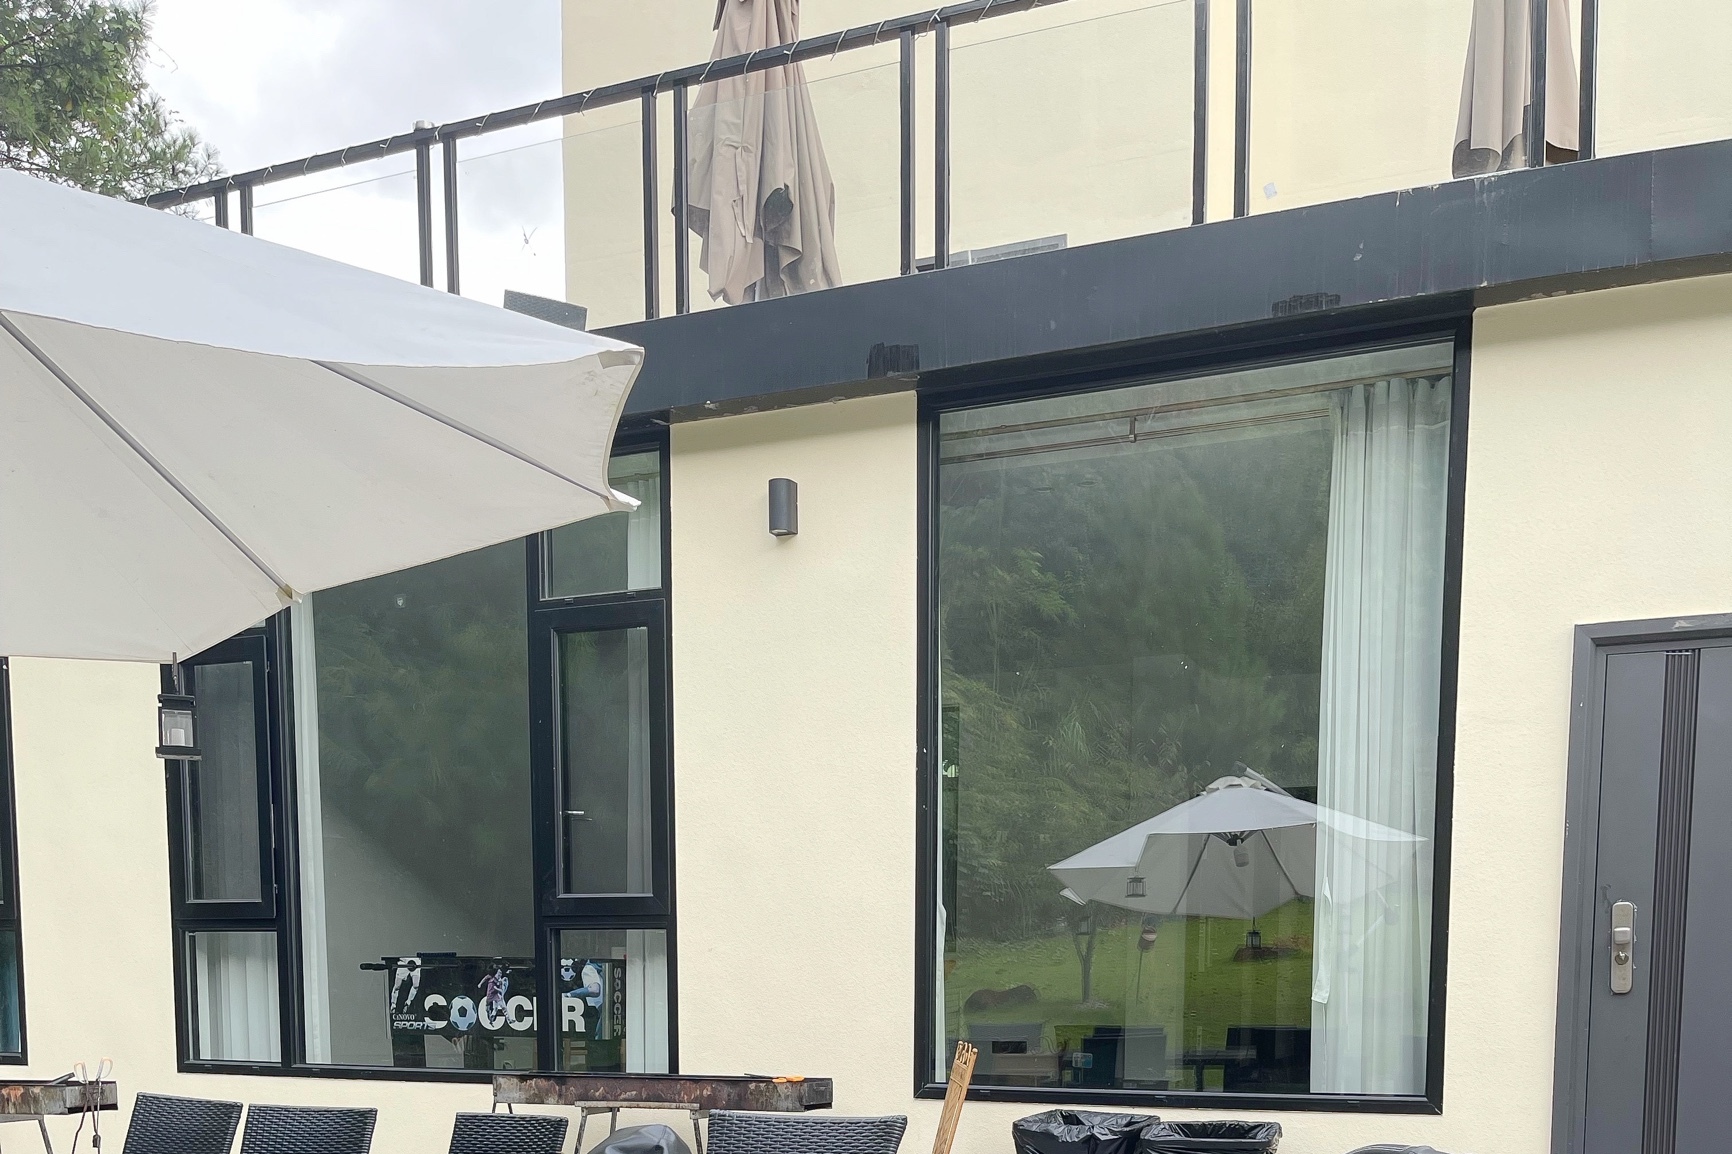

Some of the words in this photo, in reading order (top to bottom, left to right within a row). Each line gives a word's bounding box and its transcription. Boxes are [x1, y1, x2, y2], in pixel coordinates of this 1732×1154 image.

[424, 994, 586, 1032] SOCCR
[613, 967, 622, 1036] SOCCER
[392, 1021, 437, 1031] SPORTS
